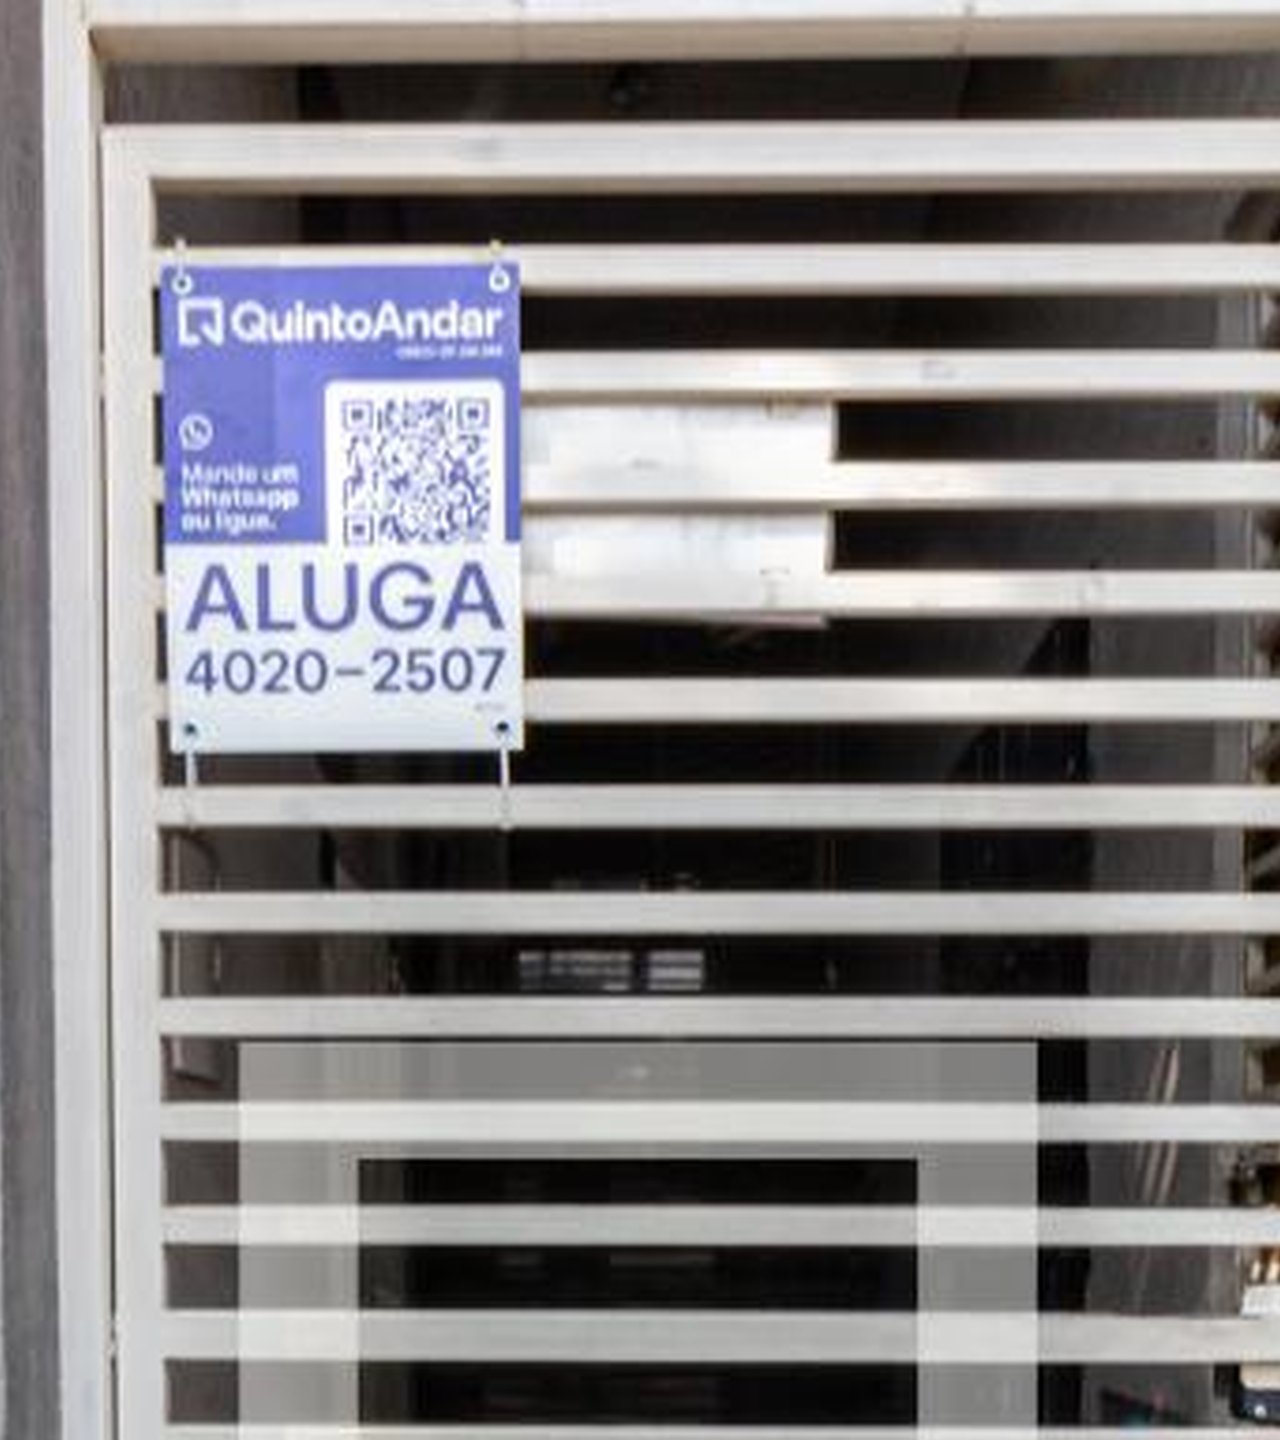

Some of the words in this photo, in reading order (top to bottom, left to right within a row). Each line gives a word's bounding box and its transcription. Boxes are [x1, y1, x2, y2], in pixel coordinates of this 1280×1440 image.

[231, 299, 503, 343] QuintoAndar
[182, 514, 211, 531] ou
[186, 561, 504, 632] ALUGA
[186, 648, 506, 695] 4020-2507
